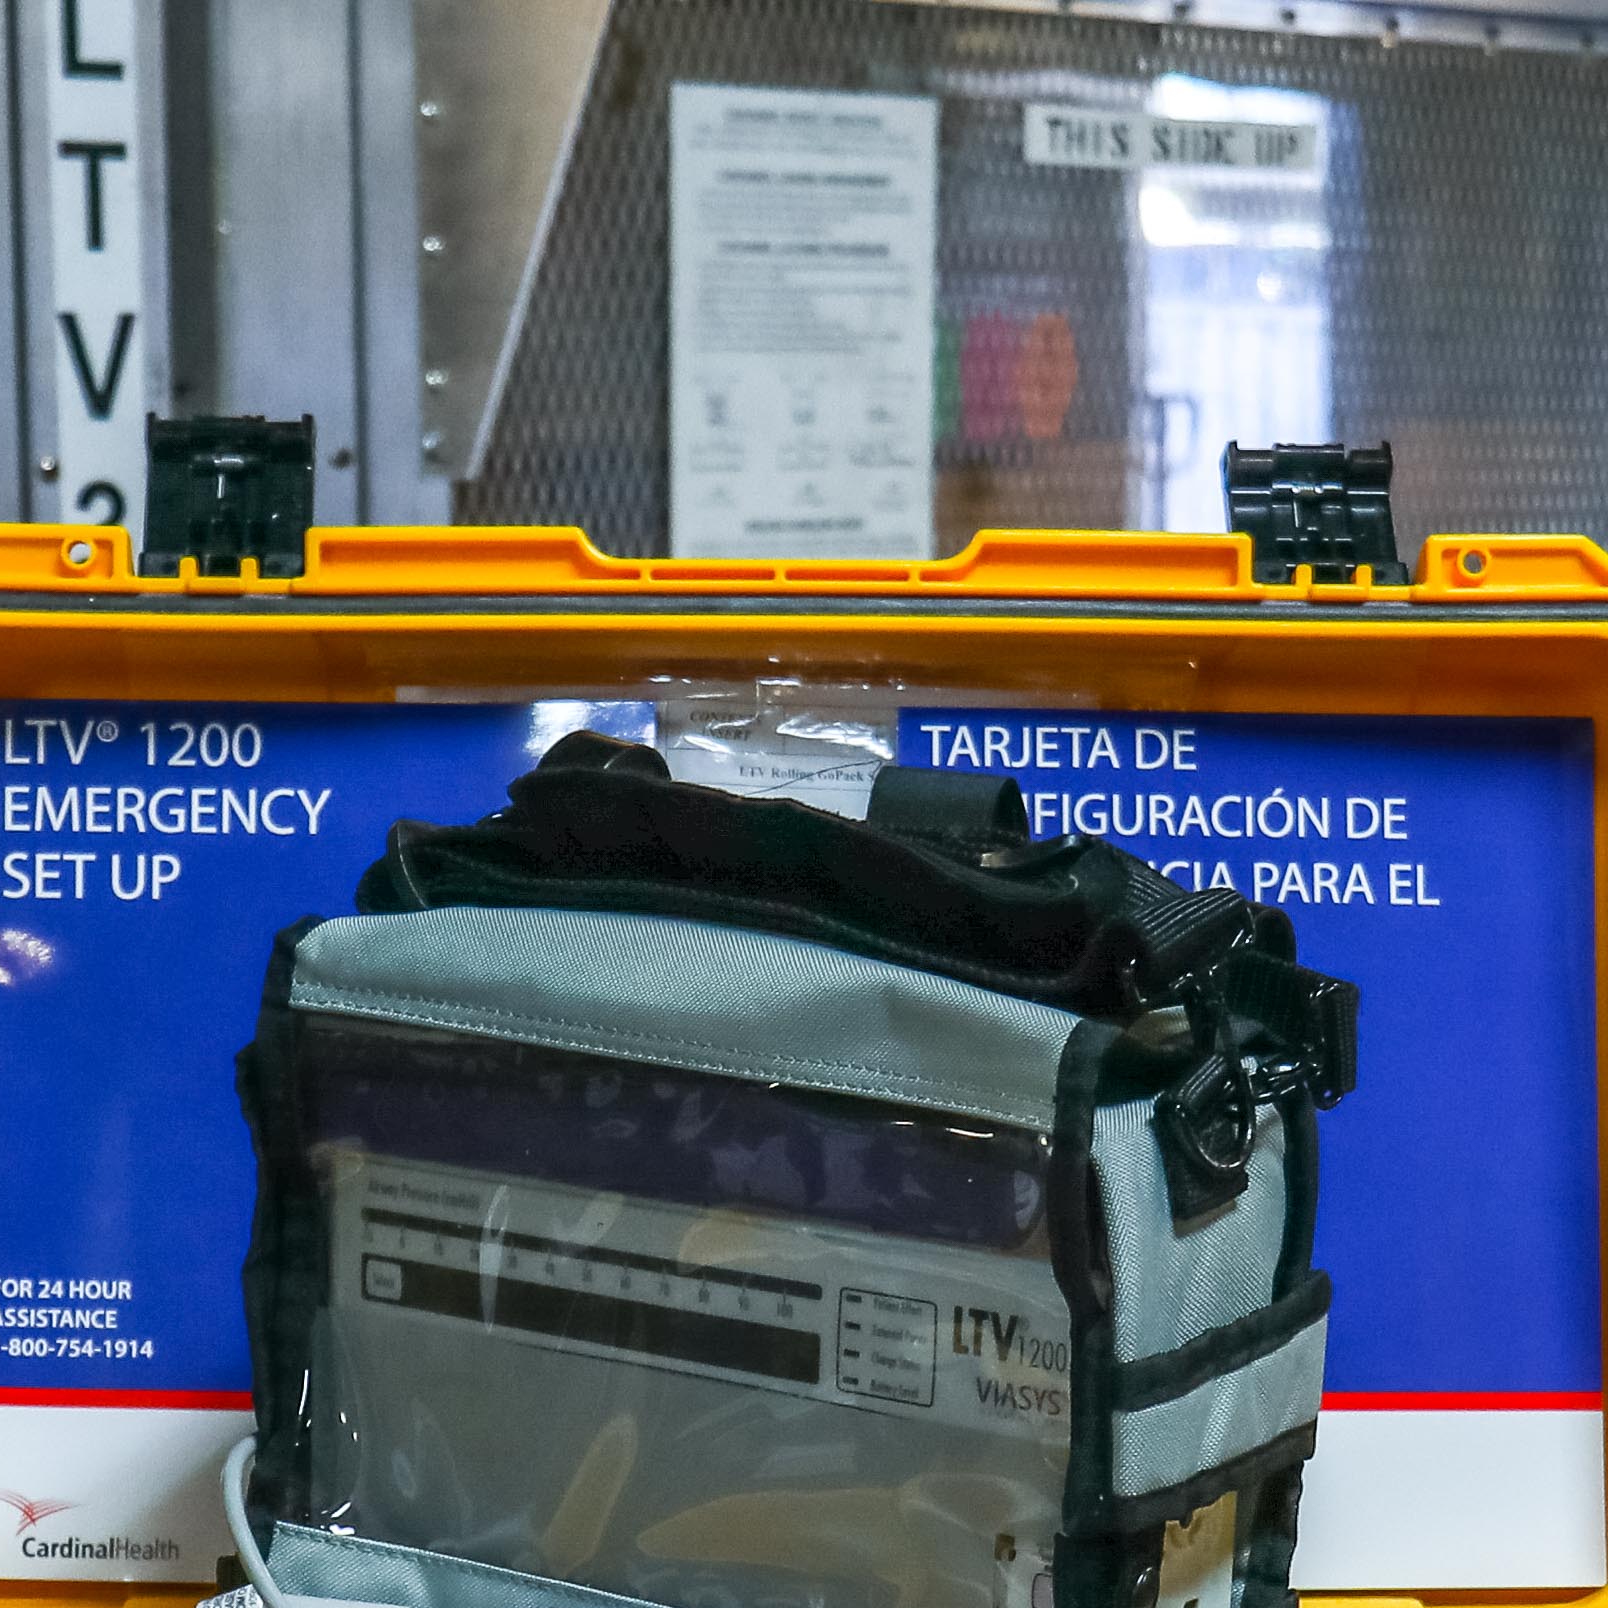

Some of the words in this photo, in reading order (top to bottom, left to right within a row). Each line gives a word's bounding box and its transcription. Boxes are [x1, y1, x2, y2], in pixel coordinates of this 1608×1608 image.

[3, 719, 120, 766] LTV®
[140, 723, 263, 767] 1200
[922, 724, 1126, 771] TARJETA
[1134, 729, 1198, 771] DE
[771, 768, 814, 782] Rolling
[817, 770, 866, 783] GoPack
[3, 788, 332, 835] EMERGENCY
[1021, 787, 1322, 841] FIGURACIÓN
[1334, 798, 1408, 841] DE
[1, 852, 98, 900] SET
[111, 855, 182, 900] UP
[1254, 863, 1376, 906] PARA
[1389, 865, 1441, 907] EL
[38, 1279, 63, 1299] 24
[68, 1279, 133, 1300] HOUR
[1019, 1336, 1067, 1373] 1200
[976, 1376, 1062, 1416] VIASYS
